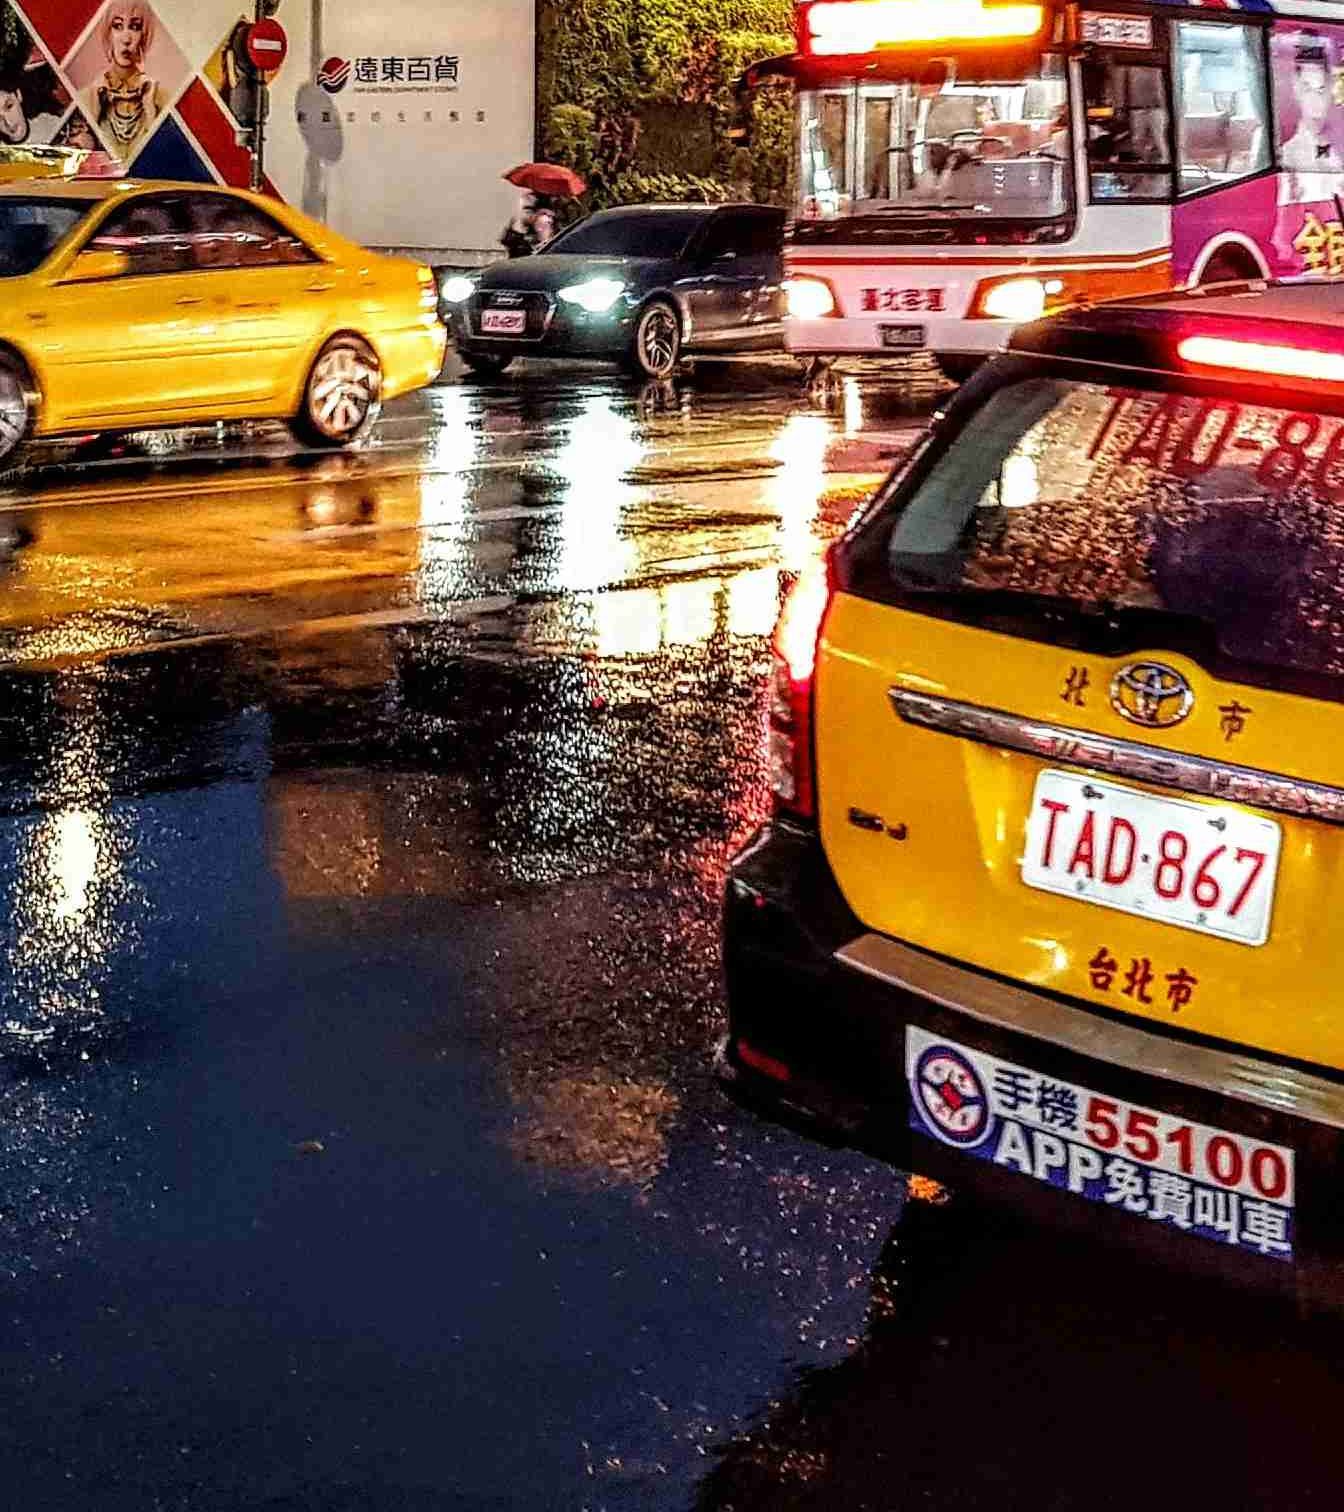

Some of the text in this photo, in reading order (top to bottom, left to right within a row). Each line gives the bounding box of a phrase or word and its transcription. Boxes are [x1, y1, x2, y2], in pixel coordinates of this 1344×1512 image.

[355, 56, 459, 83] 遠東百貨
[1060, 666, 1253, 743] 北 市
[1088, 946, 1199, 1013] 台北市
[993, 1065, 1289, 1201] 手機 55100
[992, 1120, 1294, 1255] APP免費叫車
